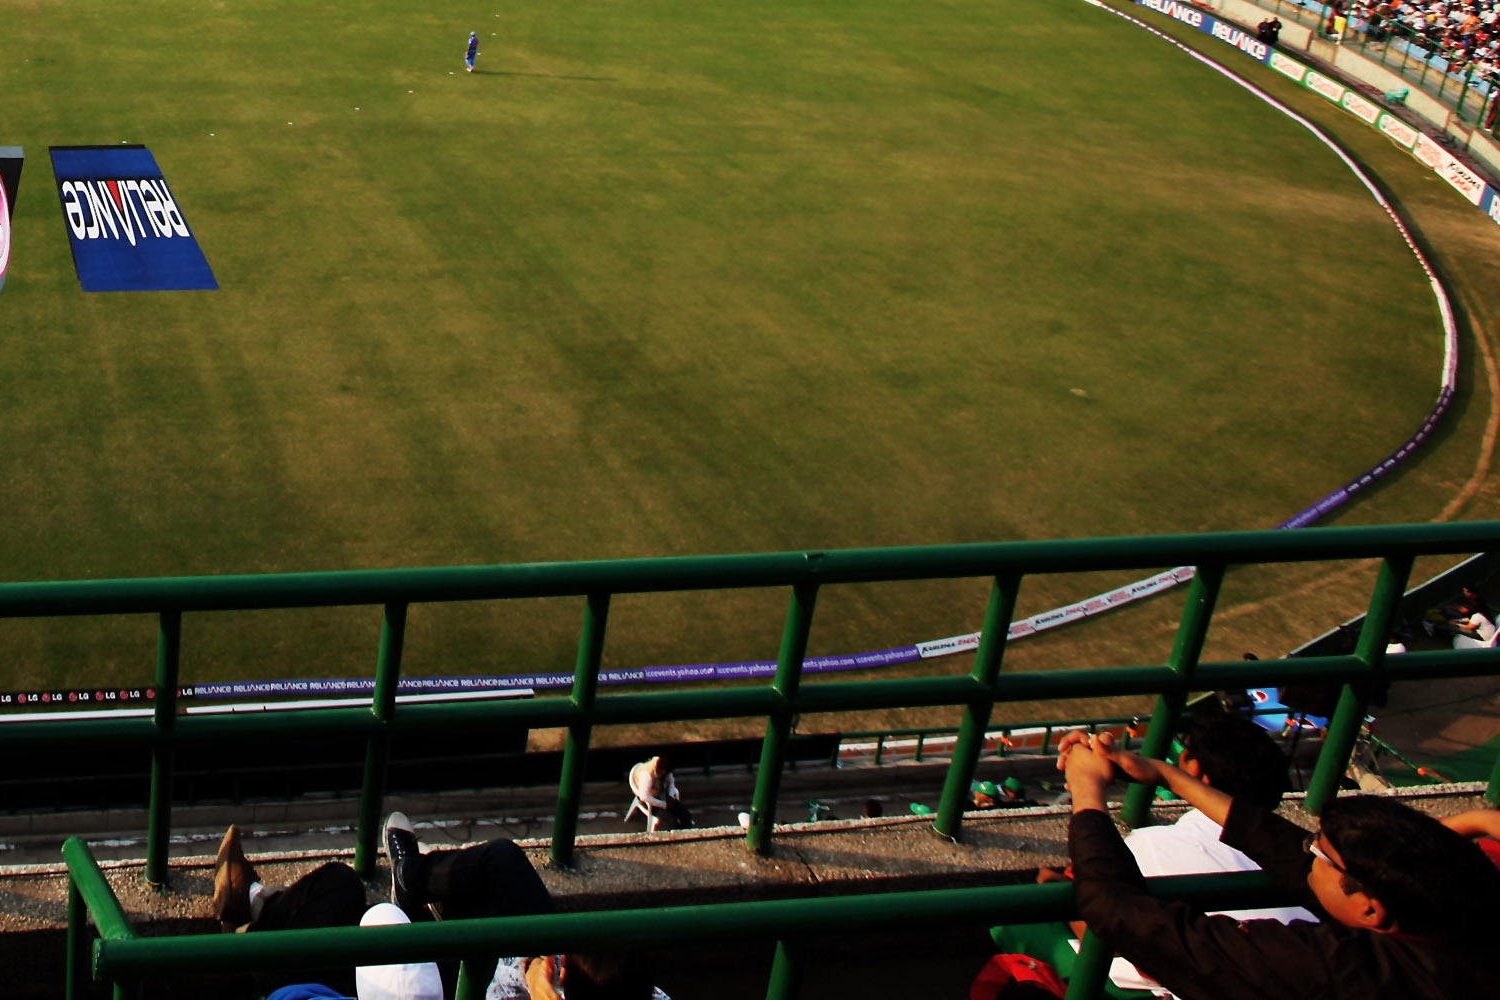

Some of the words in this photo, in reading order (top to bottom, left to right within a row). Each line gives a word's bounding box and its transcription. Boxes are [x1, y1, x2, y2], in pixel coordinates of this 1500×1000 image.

[79, 692, 89, 700] LG
[105, 691, 116, 700] LG
[130, 690, 140, 698] LG
[182, 688, 193, 696] LG
[1, 695, 11, 703] LG
[28, 694, 39, 702] LG
[52, 693, 63, 701] LG
